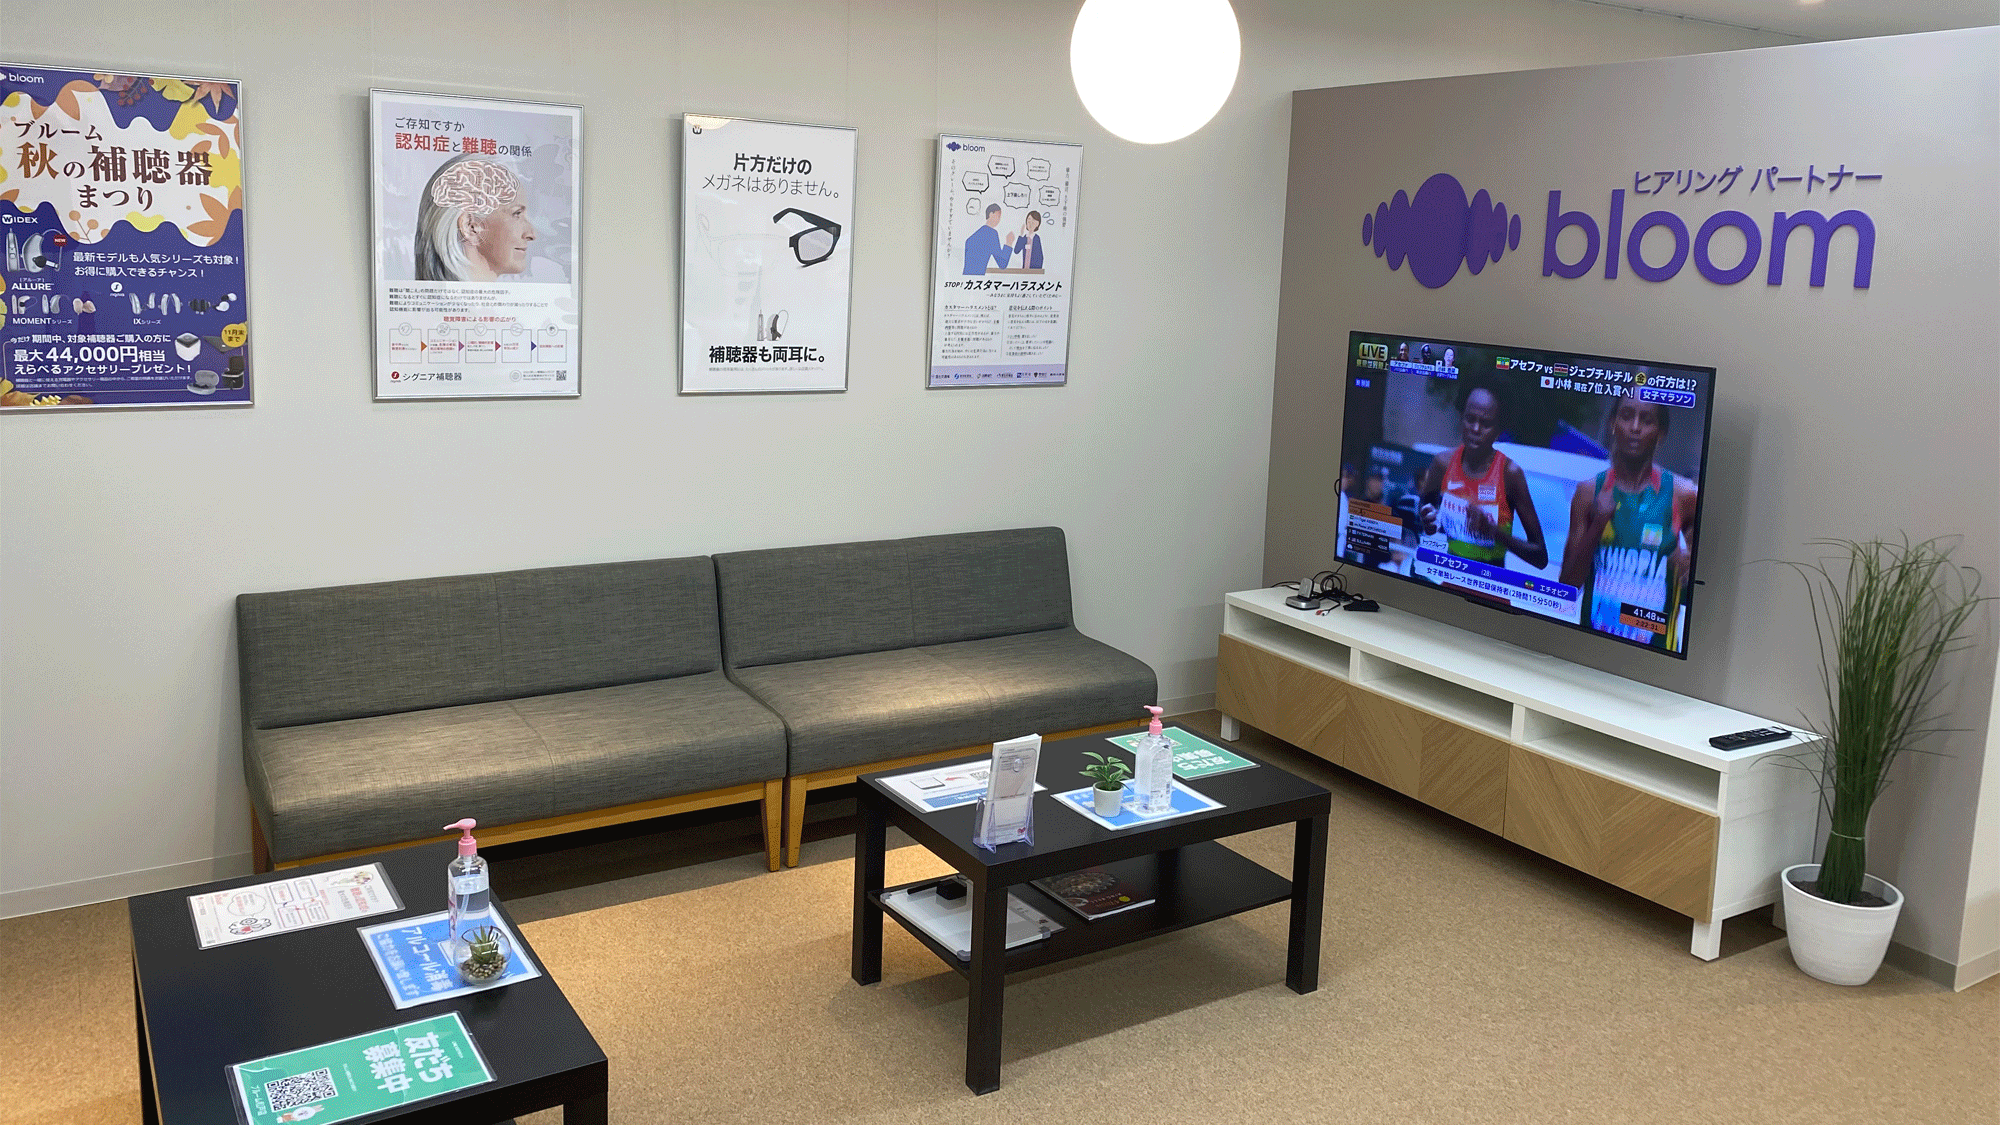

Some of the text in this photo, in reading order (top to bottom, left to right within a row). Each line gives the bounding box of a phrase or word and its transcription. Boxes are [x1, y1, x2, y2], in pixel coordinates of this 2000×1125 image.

[8, 72, 45, 84] bloom
[14, 120, 103, 141] ブルーム
[394, 117, 465, 132] ご存知ですか
[394, 132, 532, 158] 認知症と難聴の関係
[962, 143, 986, 153] bloom
[16, 141, 213, 186] 秋の補聴器
[733, 152, 813, 175] 片方だけの
[702, 174, 839, 199] メガネはありません。
[1633, 163, 1883, 195] ヒアリング パートナー
[77, 184, 153, 212] まつり
[1, 214, 39, 224] WIDEX
[1541, 188, 1876, 289] bloom
[963, 279, 1063, 292] カスタマーハラスメント
[13, 346, 166, 363] 最大44,000円相当
[709, 345, 825, 364] 補聴器も両耳に。
[1361, 344, 1386, 359] LIVE
[402, 372, 463, 382] シグニア補聴器
[1510, 359, 1543, 374] アセファ
[1569, 365, 1633, 383] ジェプチルチル
[1555, 378, 1573, 391] 小林
[1642, 390, 1693, 404] 女子マラソン
[1539, 584, 1569, 598] エチオピア
[403, 1031, 454, 1083] 友だち
[362, 1041, 414, 1094] 募集中
